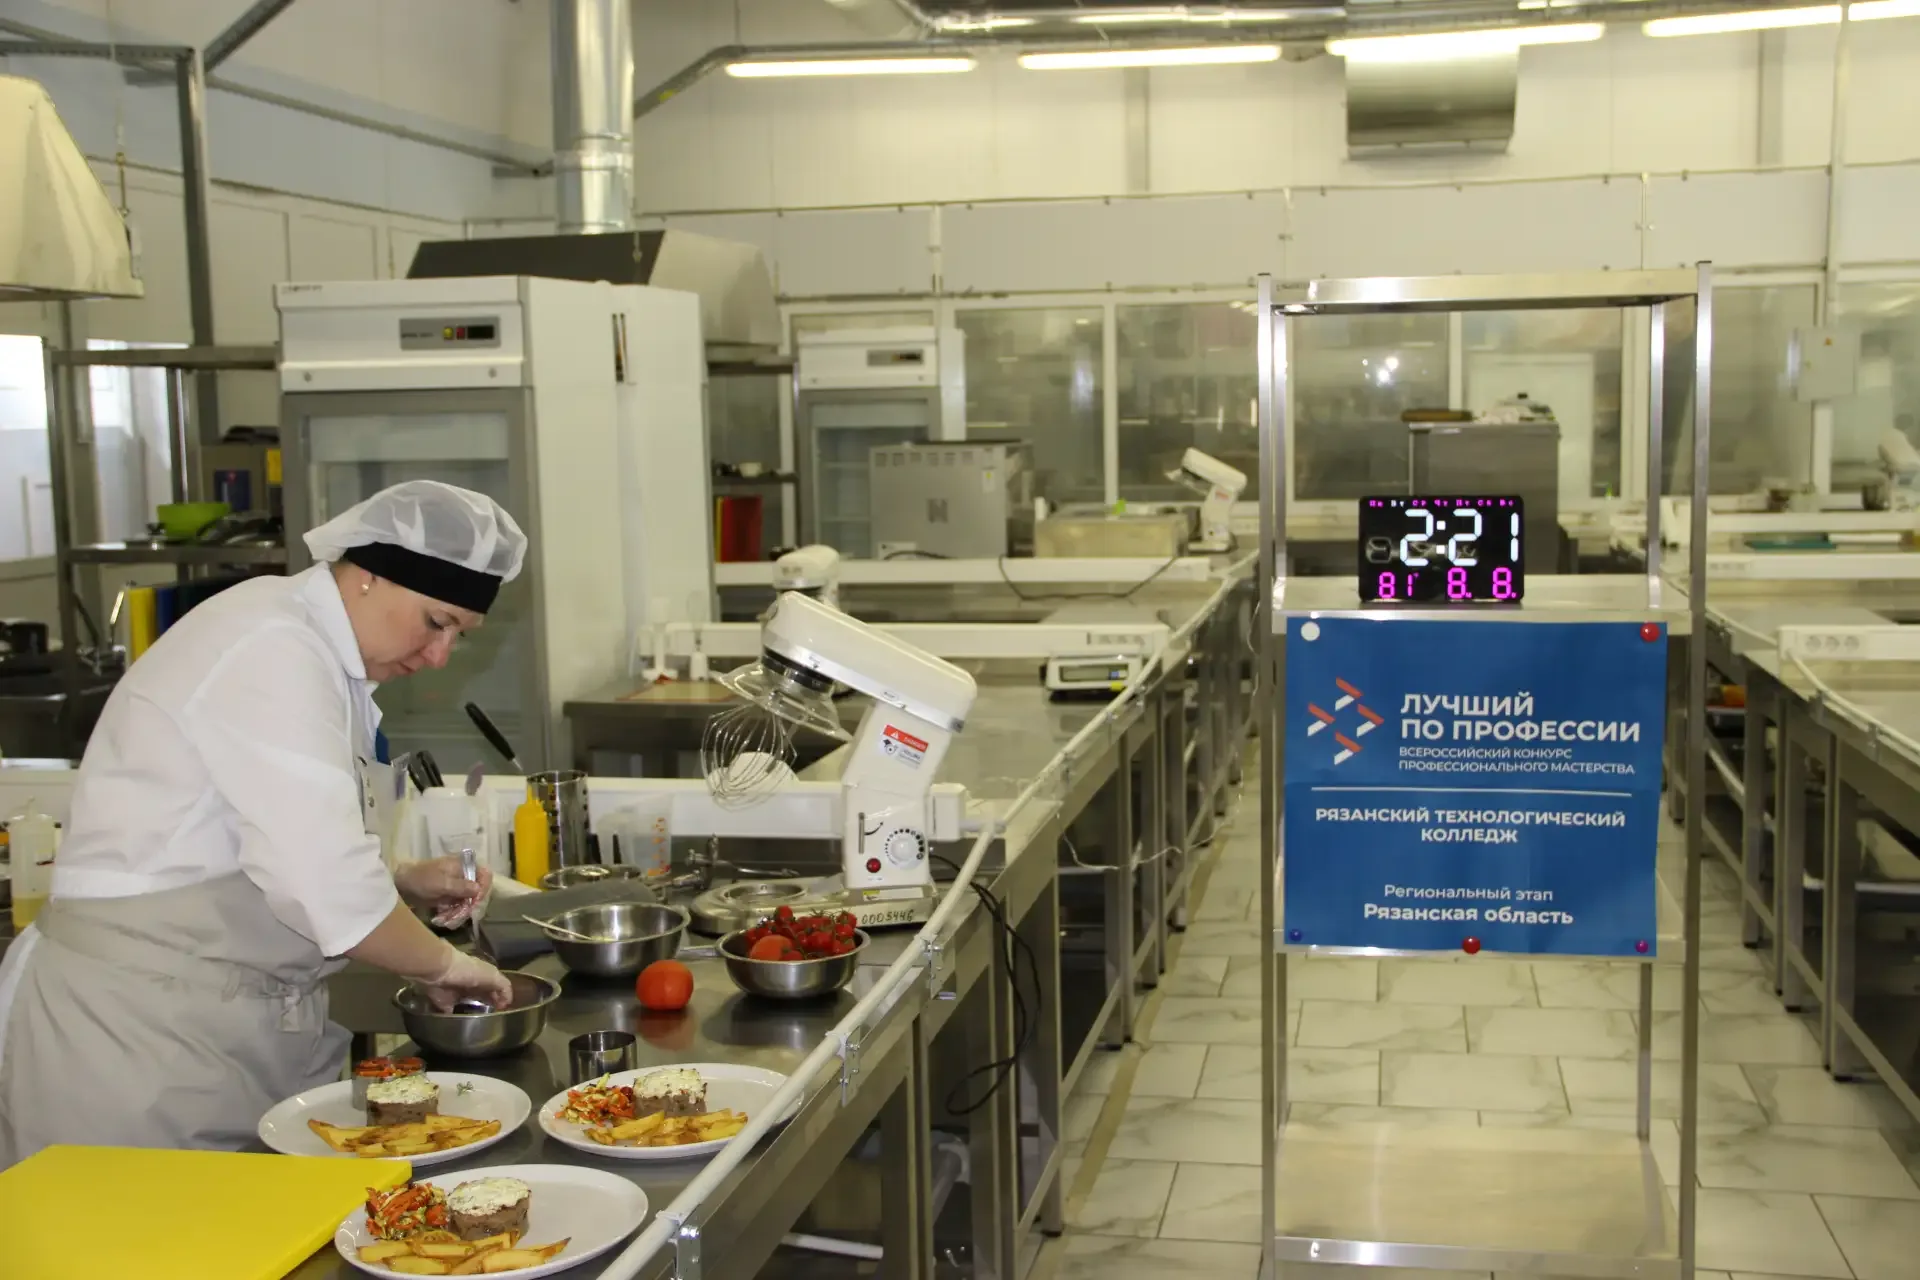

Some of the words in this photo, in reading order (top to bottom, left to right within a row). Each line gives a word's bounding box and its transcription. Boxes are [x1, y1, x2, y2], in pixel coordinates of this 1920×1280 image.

[1400, 508, 1519, 567] 2:21
[1400, 691, 1534, 716] ЛУЧШИЙ
[1401, 718, 1444, 740] ПО
[1452, 720, 1640, 742] ПРОФЕССИИ
[1399, 746, 1512, 759] ВСЕРОССИЙСКИЙ
[1513, 748, 1573, 760] КОНКУРС
[1399, 760, 1549, 772] ПРОФЕССИОНАЛЬНОГО
[1550, 762, 1636, 775] МАСТЕРСТВА
[1315, 807, 1430, 824] РЯЗАНСКИЙ
[1435, 809, 1626, 827] ТЕХНОЛОГИЧЕСКИЙ
[1421, 828, 1518, 844] КОЛЛЕДЖ
[1384, 884, 1511, 900] Региональный
[1515, 889, 1553, 902] этап
[1364, 903, 1478, 921] Рязанская
[1484, 906, 1574, 924] область
